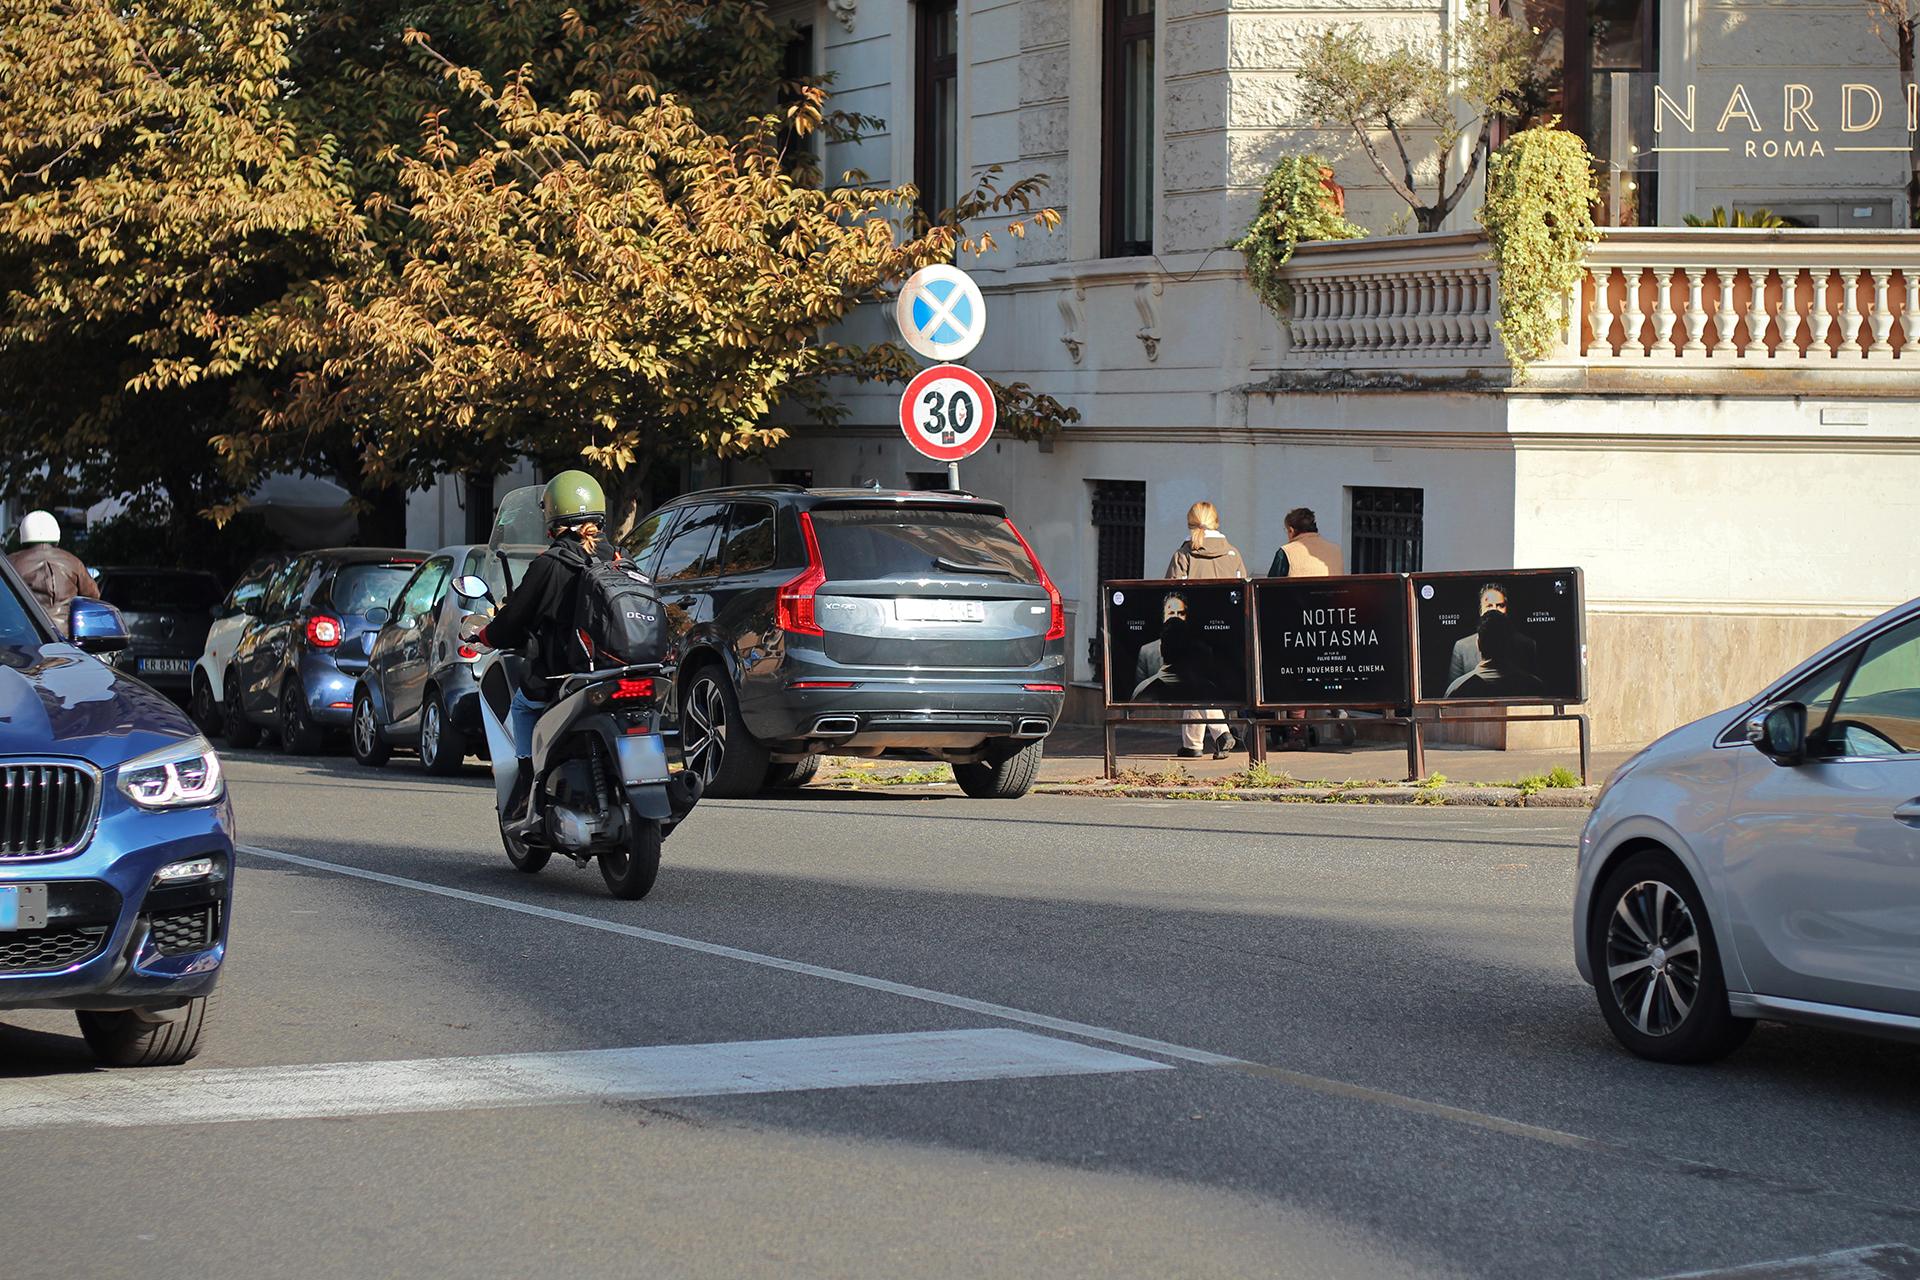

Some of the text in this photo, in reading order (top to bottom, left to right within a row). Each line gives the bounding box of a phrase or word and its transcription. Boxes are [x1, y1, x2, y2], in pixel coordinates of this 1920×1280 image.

[1654, 84, 1918, 132] NARDI
[1745, 140, 1825, 158] ROMA
[923, 390, 974, 434] 30
[1303, 608, 1357, 625] NOTTE
[1284, 629, 1379, 648] FANTASMA
[1306, 665, 1343, 674] NOVEMBRE
[1346, 665, 1355, 673] AL
[1358, 664, 1385, 672] CINEMA
